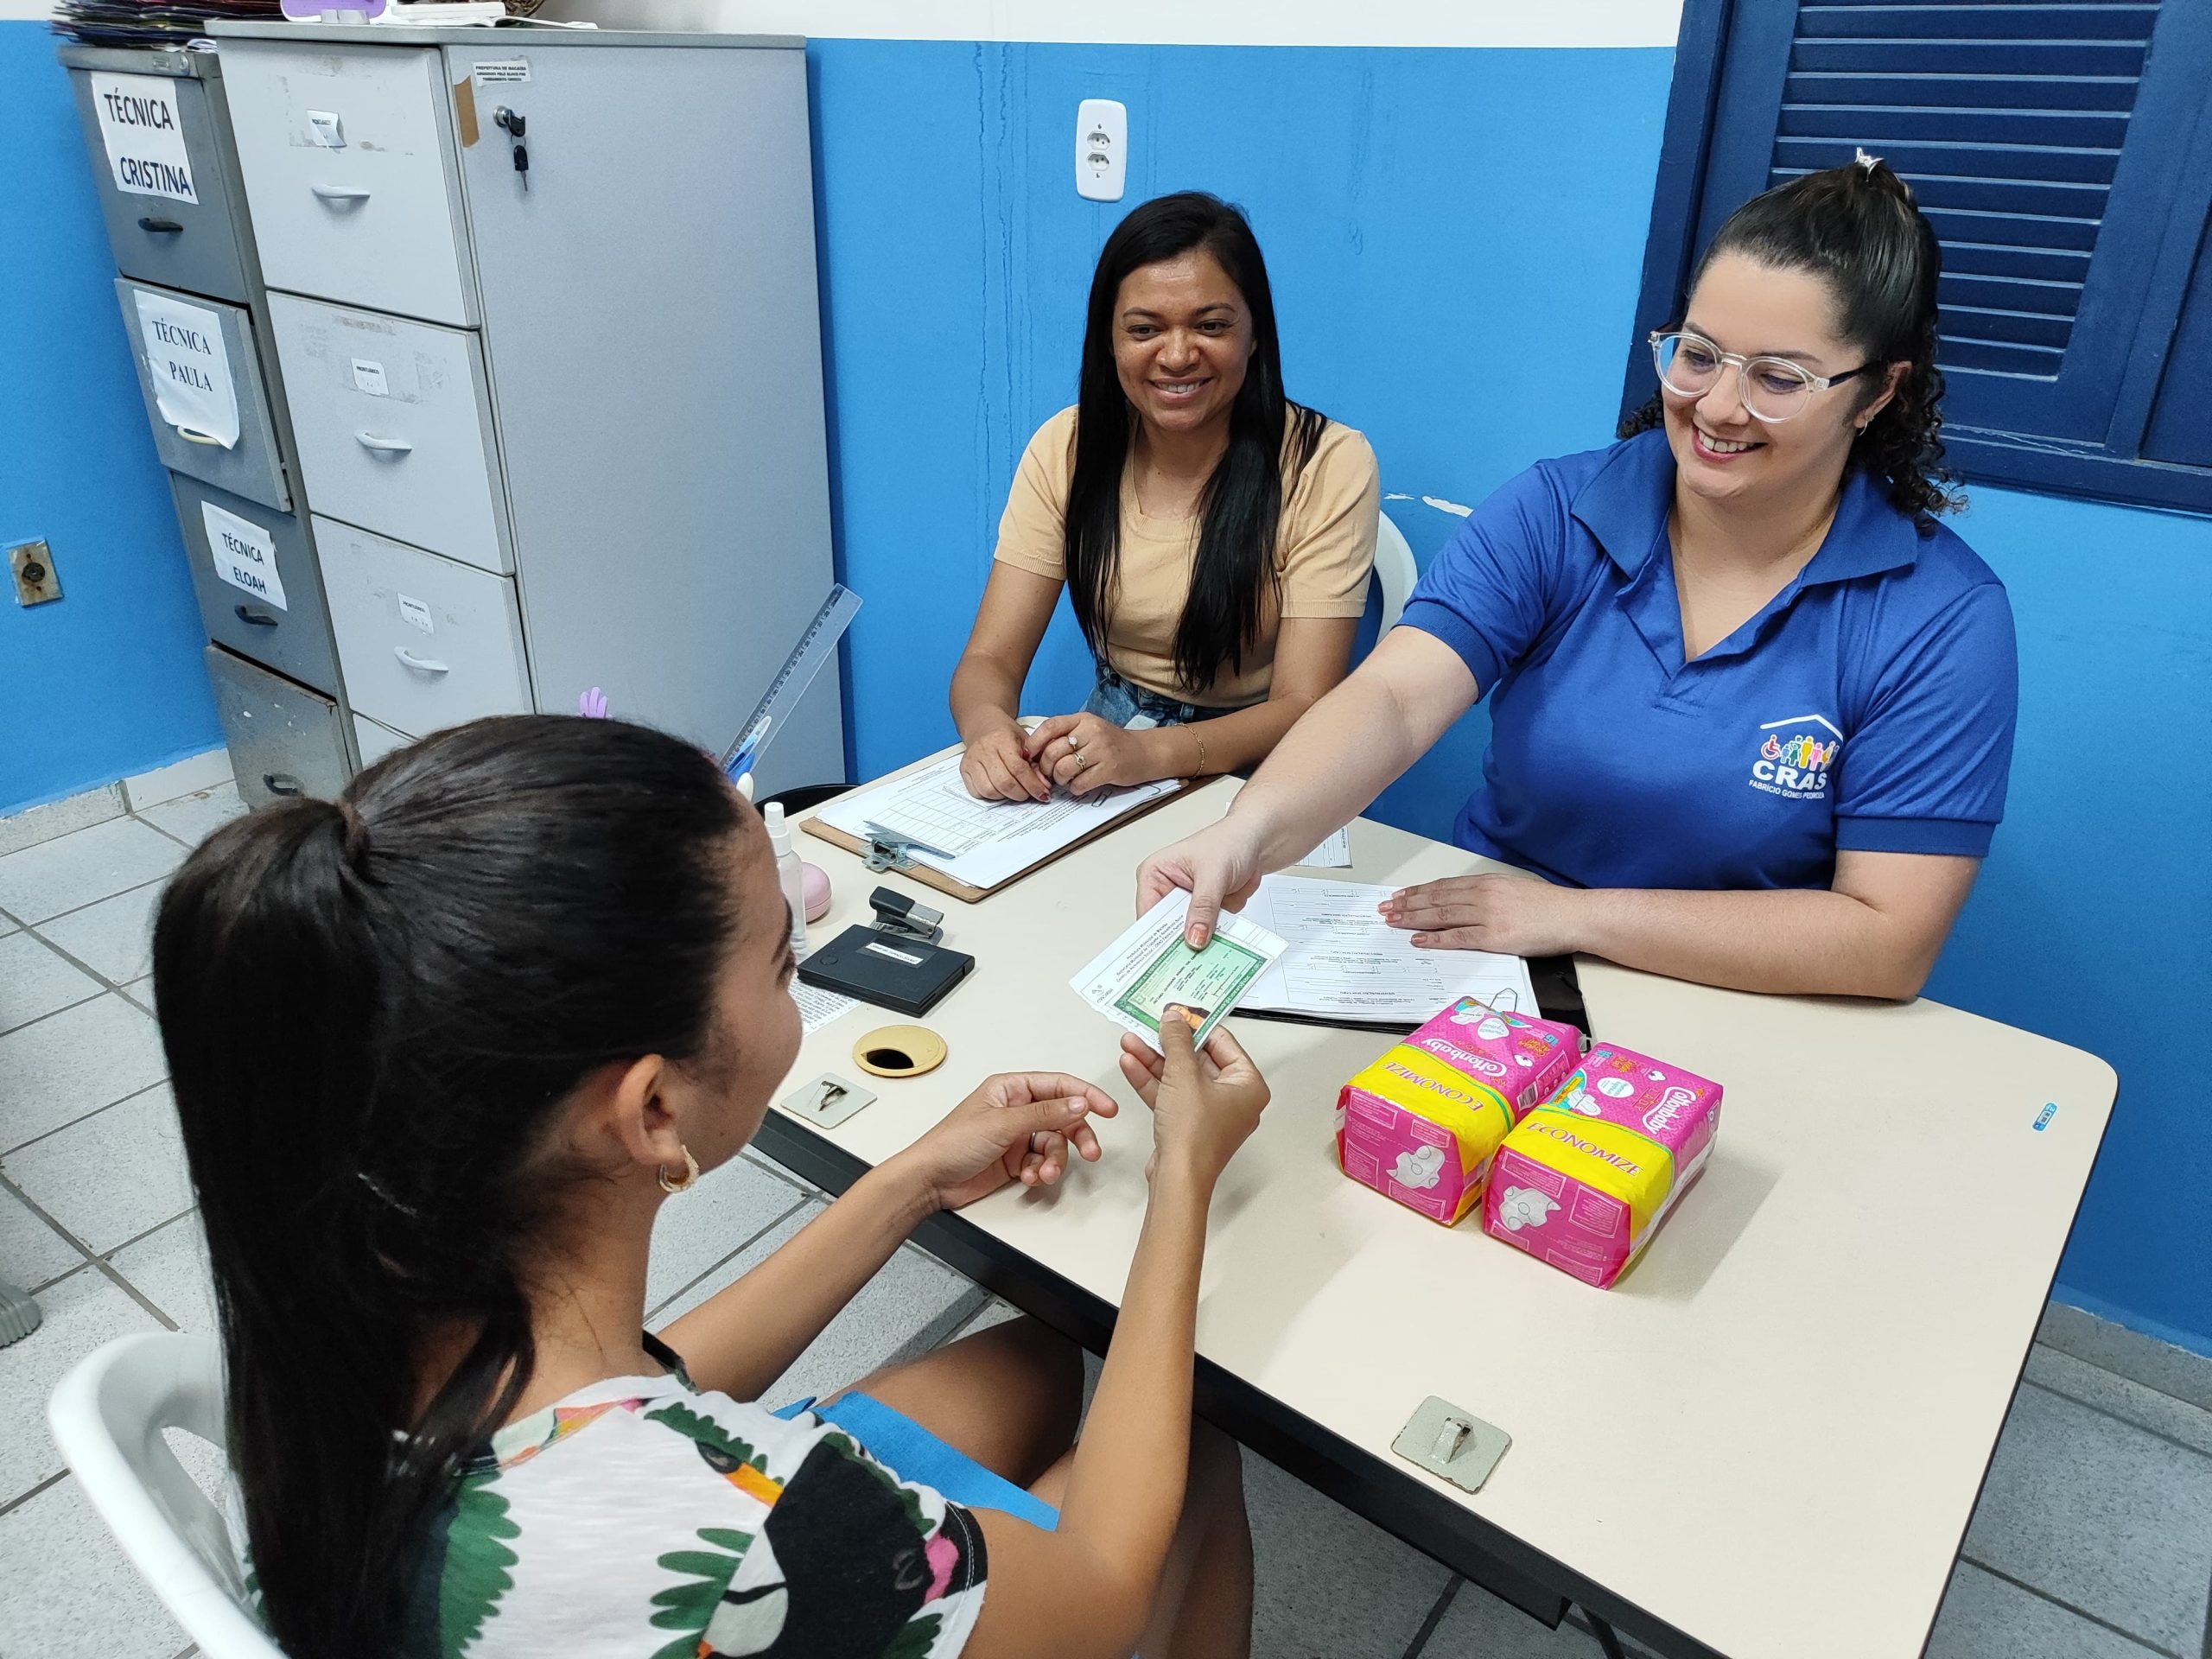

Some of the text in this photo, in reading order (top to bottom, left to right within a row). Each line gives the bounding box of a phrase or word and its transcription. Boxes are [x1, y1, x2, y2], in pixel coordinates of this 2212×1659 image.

[104, 87, 175, 130] TÉCNICA
[120, 156, 192, 196] CRISTINA
[152, 317, 212, 355] TÉCNICA
[168, 361, 213, 391] PAULA
[221, 532, 264, 566] TÉCNICA
[233, 566, 267, 594] ELOAH
[1749, 779, 1781, 794] FABRÍCIO
[1782, 790, 1802, 798] GOMES
[1752, 760, 1827, 790] CRAS
[1421, 1038, 1507, 1077] Cottonbaby
[1383, 1062, 1484, 1111] ECONOMIZE
[1642, 1086, 1697, 1135] Cottonbaby
[1526, 1122, 1644, 1177] ECONOMIZE
